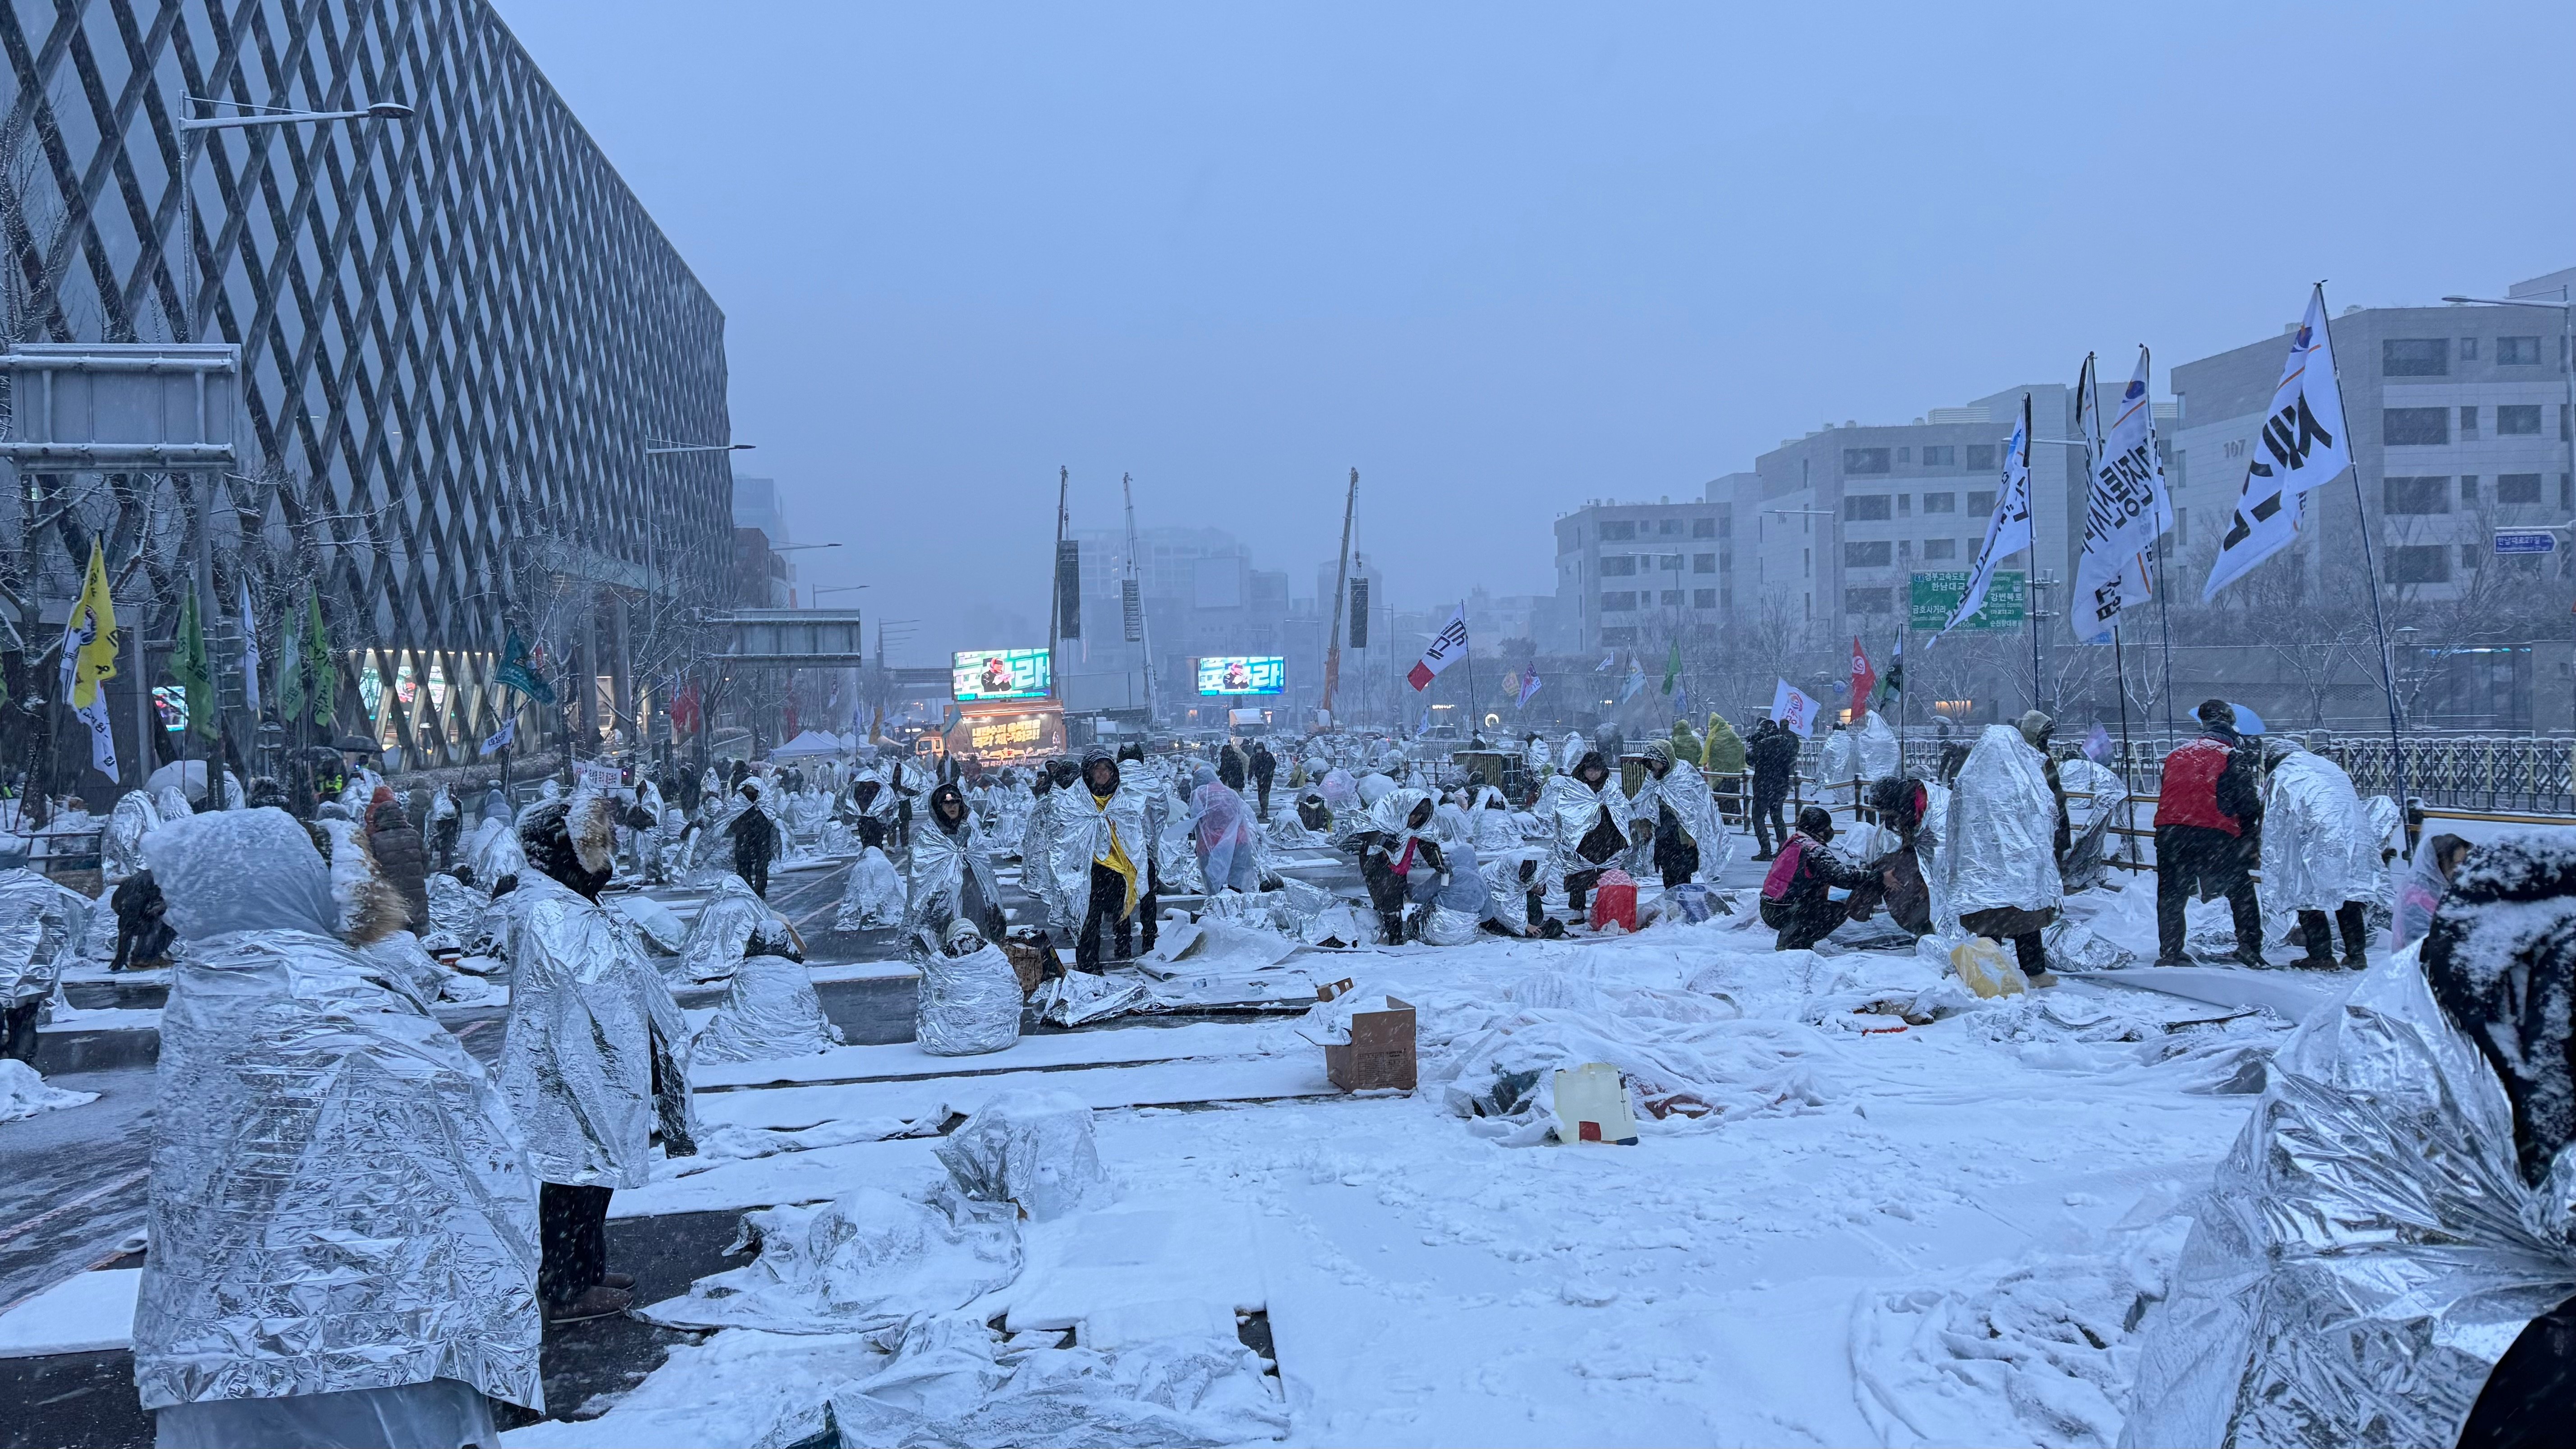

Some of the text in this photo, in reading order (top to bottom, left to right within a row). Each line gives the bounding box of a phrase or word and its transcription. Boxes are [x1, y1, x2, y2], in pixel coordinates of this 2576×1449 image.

[2224, 439, 2245, 458] 107
[1925, 572, 1965, 581] 경부고속도로
[1932, 582, 1965, 591] 한남대교
[1991, 593, 2023, 602] 강변북로
[1913, 605, 1946, 614] 금호사거리
